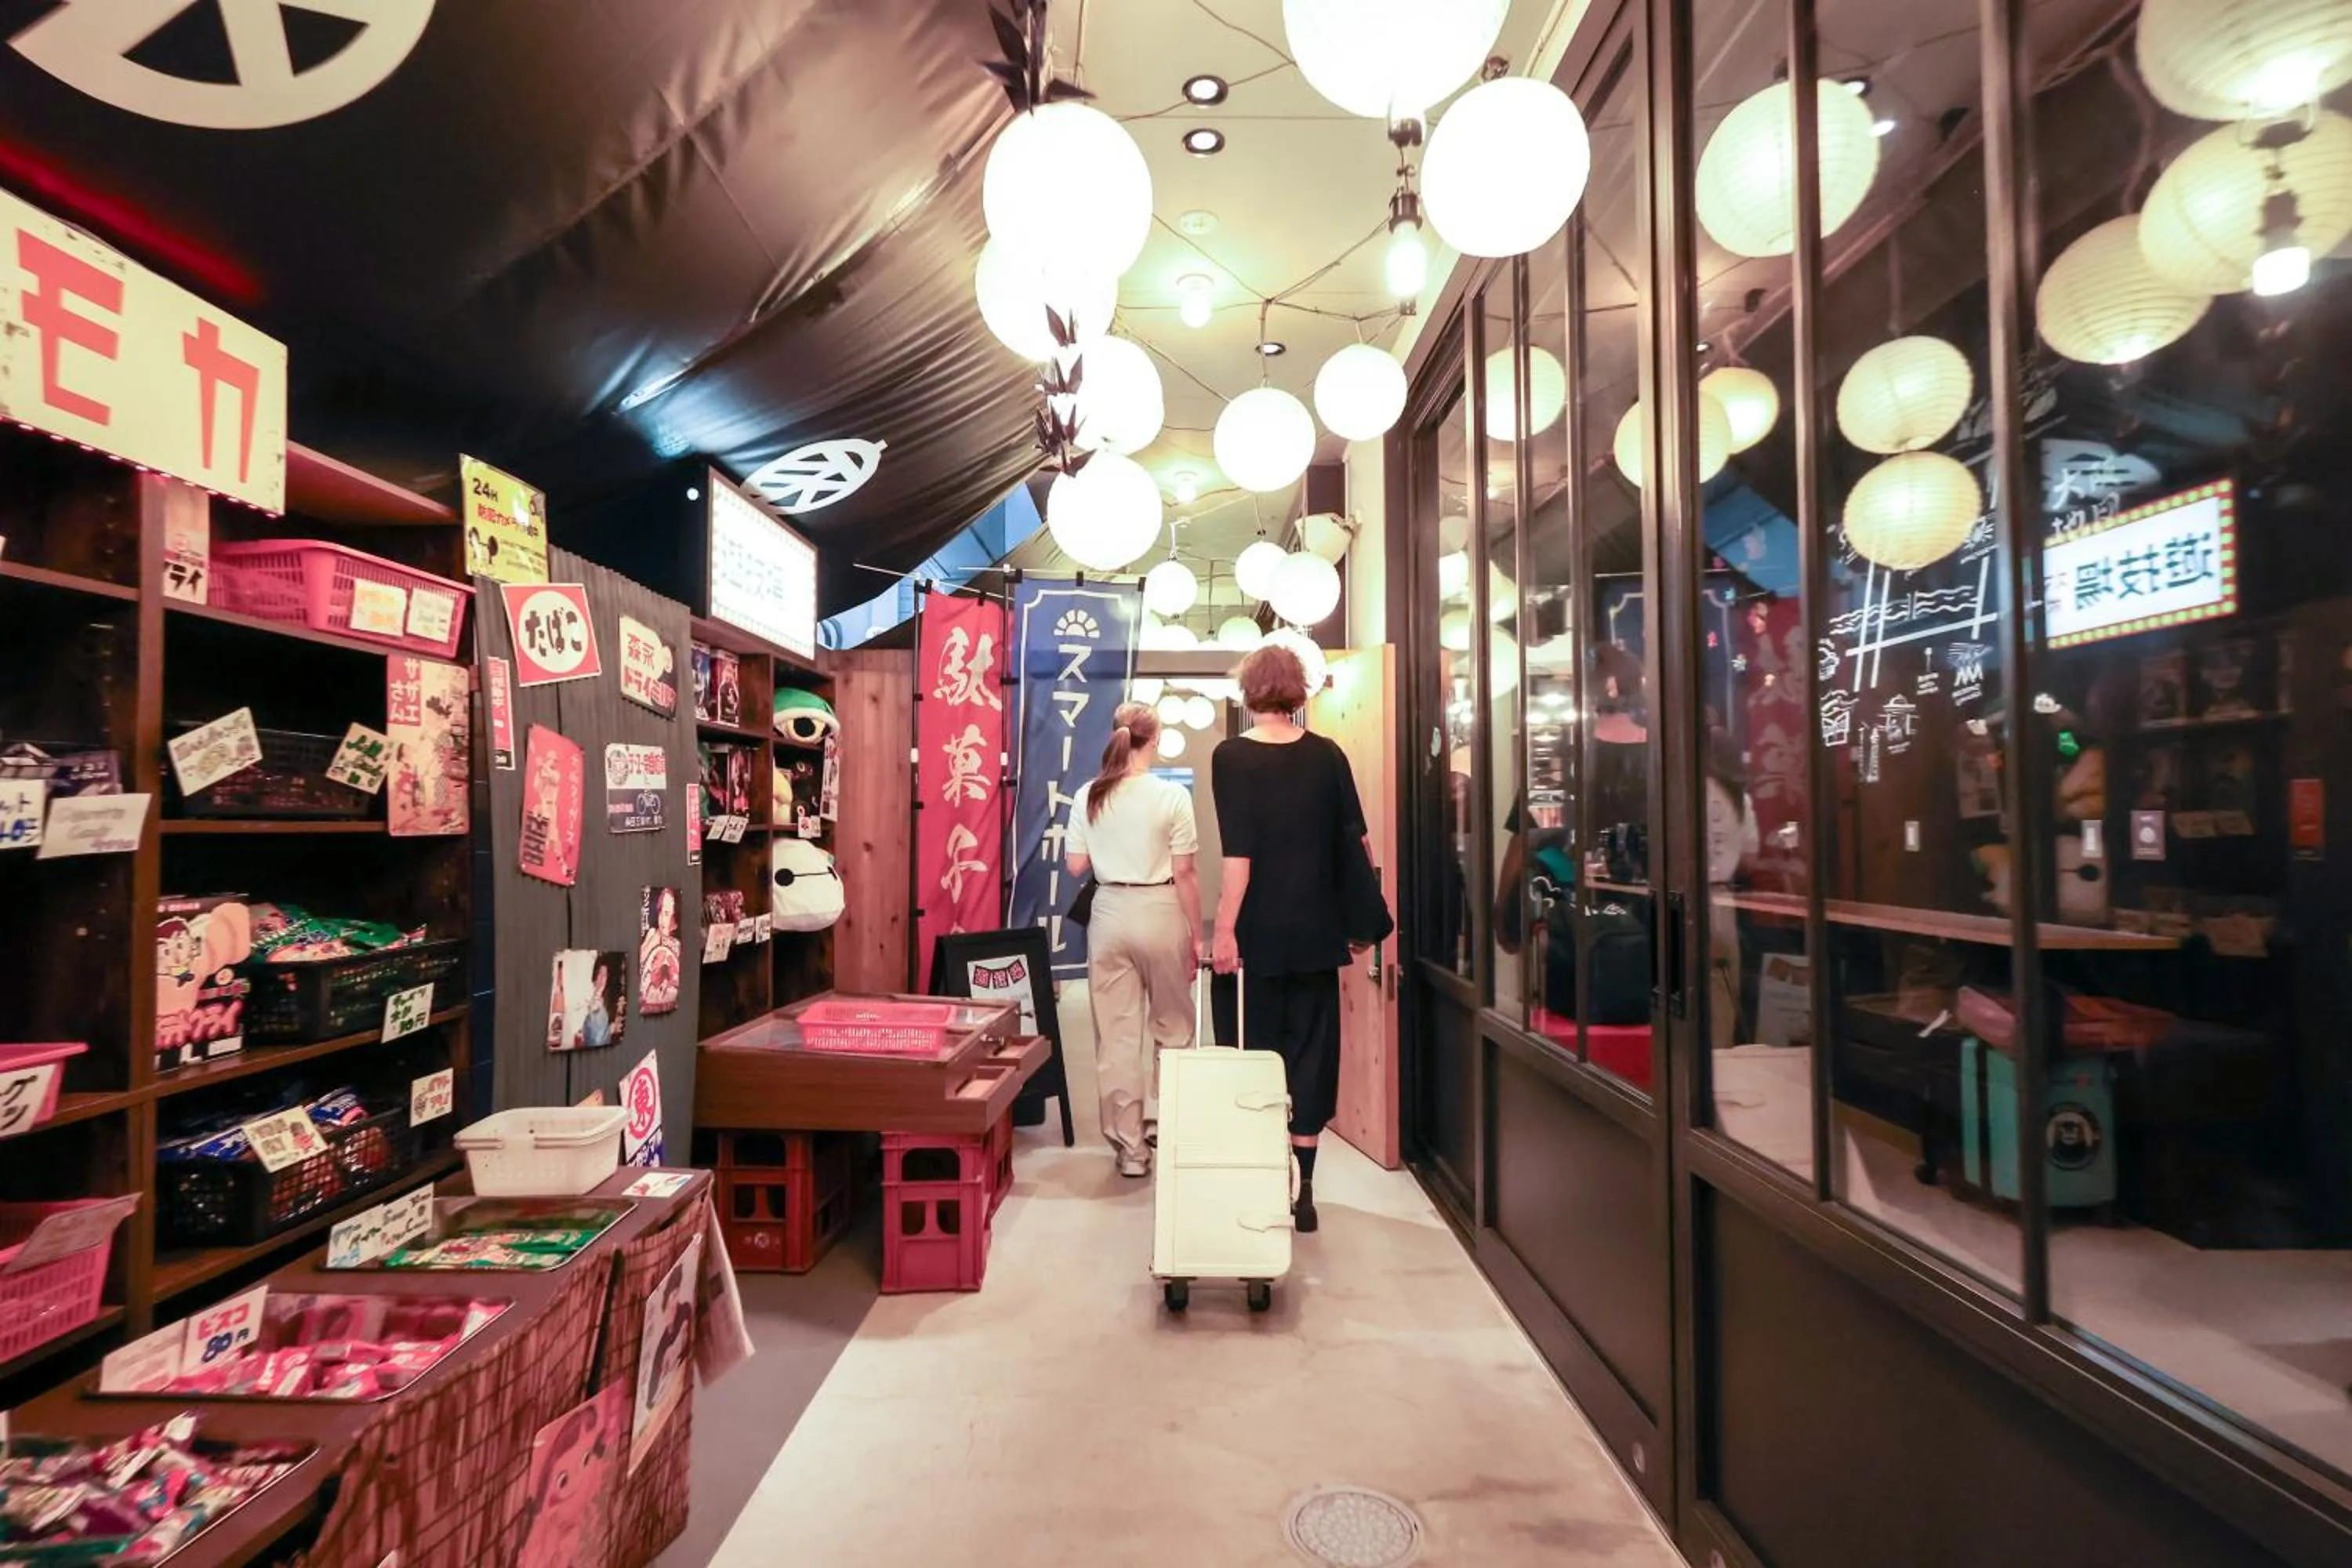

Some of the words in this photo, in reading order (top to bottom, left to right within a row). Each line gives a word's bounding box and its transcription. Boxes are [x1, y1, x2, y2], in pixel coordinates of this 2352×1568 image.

[473, 478, 498, 502] 24H
[524, 607, 583, 657] たばこ
[389, 682, 404, 723] さん
[404, 658, 420, 723] サザエ
[933, 626, 1002, 933] 駄菓子
[197, 1303, 249, 1340] ビスコ
